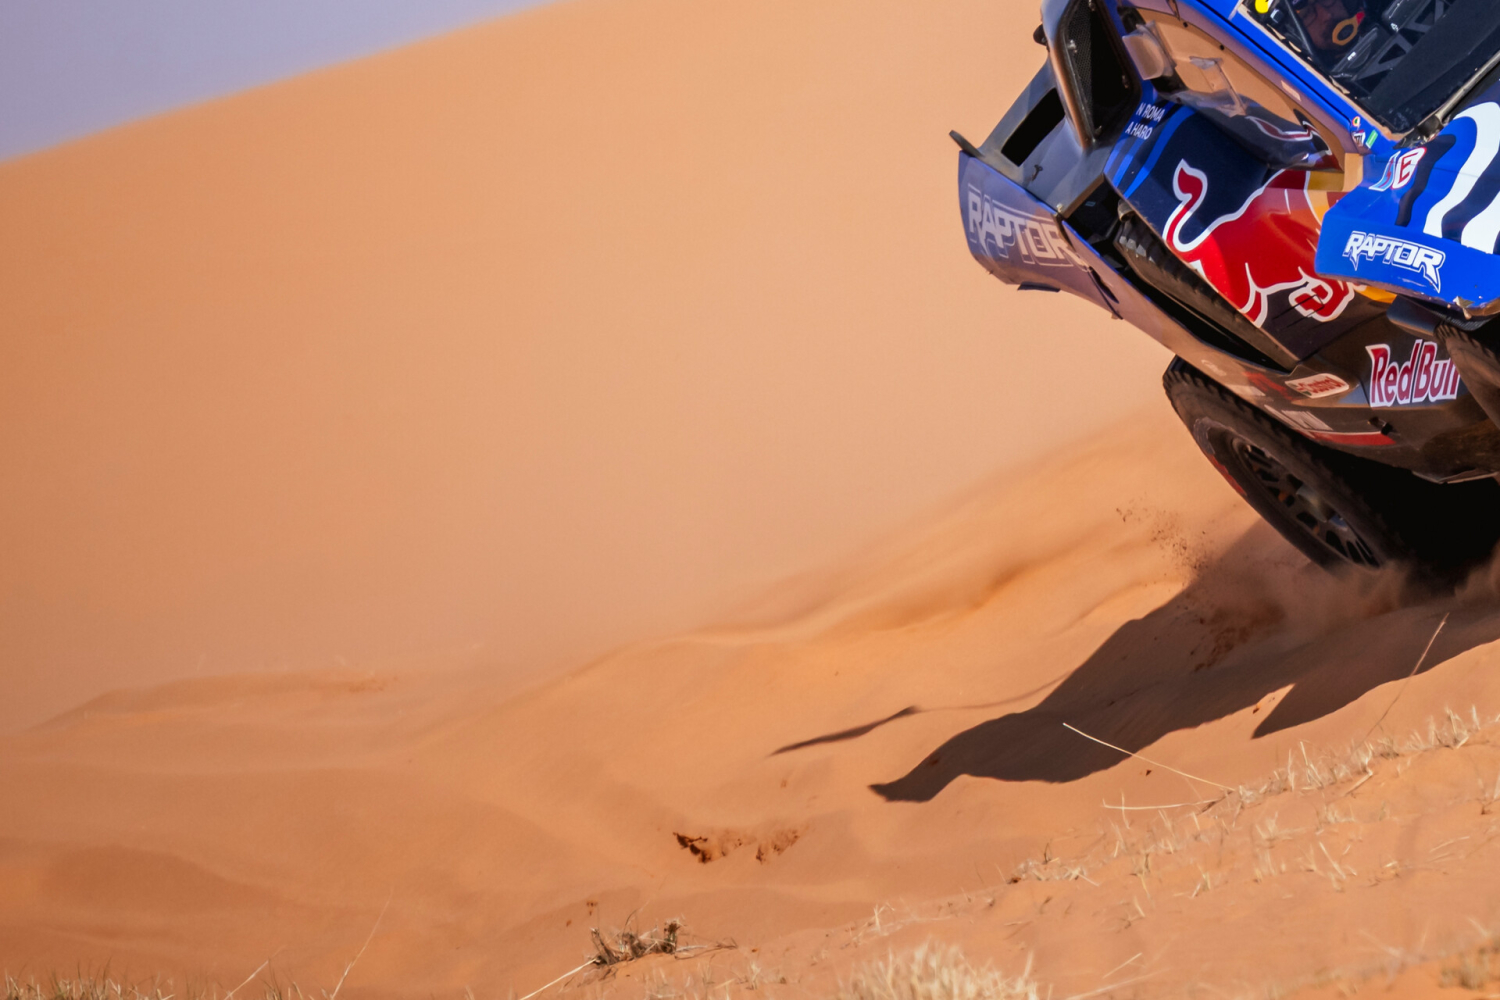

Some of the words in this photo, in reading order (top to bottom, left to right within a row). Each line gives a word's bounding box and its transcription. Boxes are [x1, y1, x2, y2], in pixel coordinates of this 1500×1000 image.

[1131, 123, 1153, 140] HARO
[1142, 104, 1166, 122] ROMA
[967, 184, 1090, 271] RAPTOR
[1343, 231, 1445, 293] RAPTOR
[1365, 339, 1423, 407] Red
